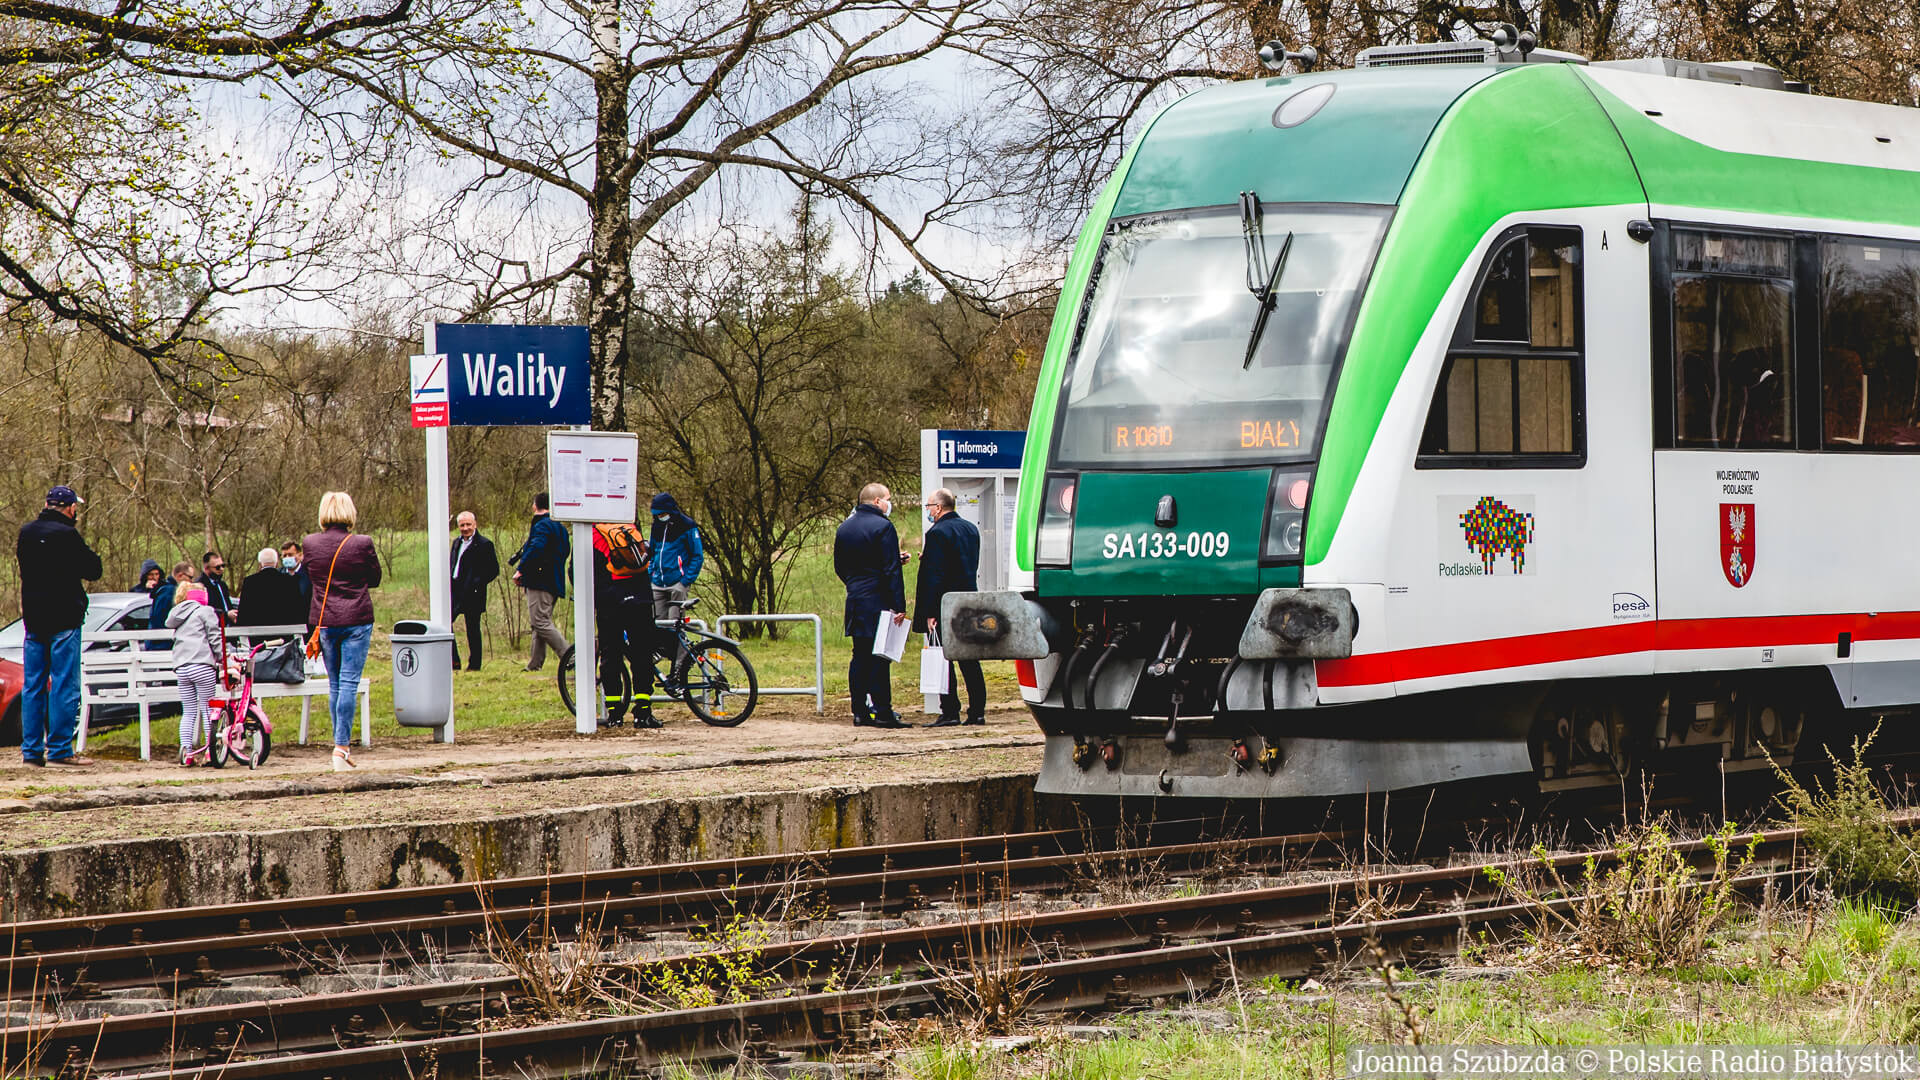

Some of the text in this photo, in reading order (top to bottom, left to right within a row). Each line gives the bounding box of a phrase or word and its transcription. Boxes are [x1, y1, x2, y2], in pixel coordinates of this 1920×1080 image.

[1601, 230, 1609, 251] A
[462, 352, 566, 409] Waliły
[1116, 426, 1129, 448] R
[1132, 425, 1174, 447] 10610
[957, 440, 998, 457] informacja
[1715, 468, 1760, 481] WOJEWÓDZTWO
[1722, 484, 1754, 495] PODLASKIE
[1102, 531, 1230, 559] SA133-009
[1439, 562, 1483, 577] Podlaskie
[1613, 602, 1646, 614] pesa
